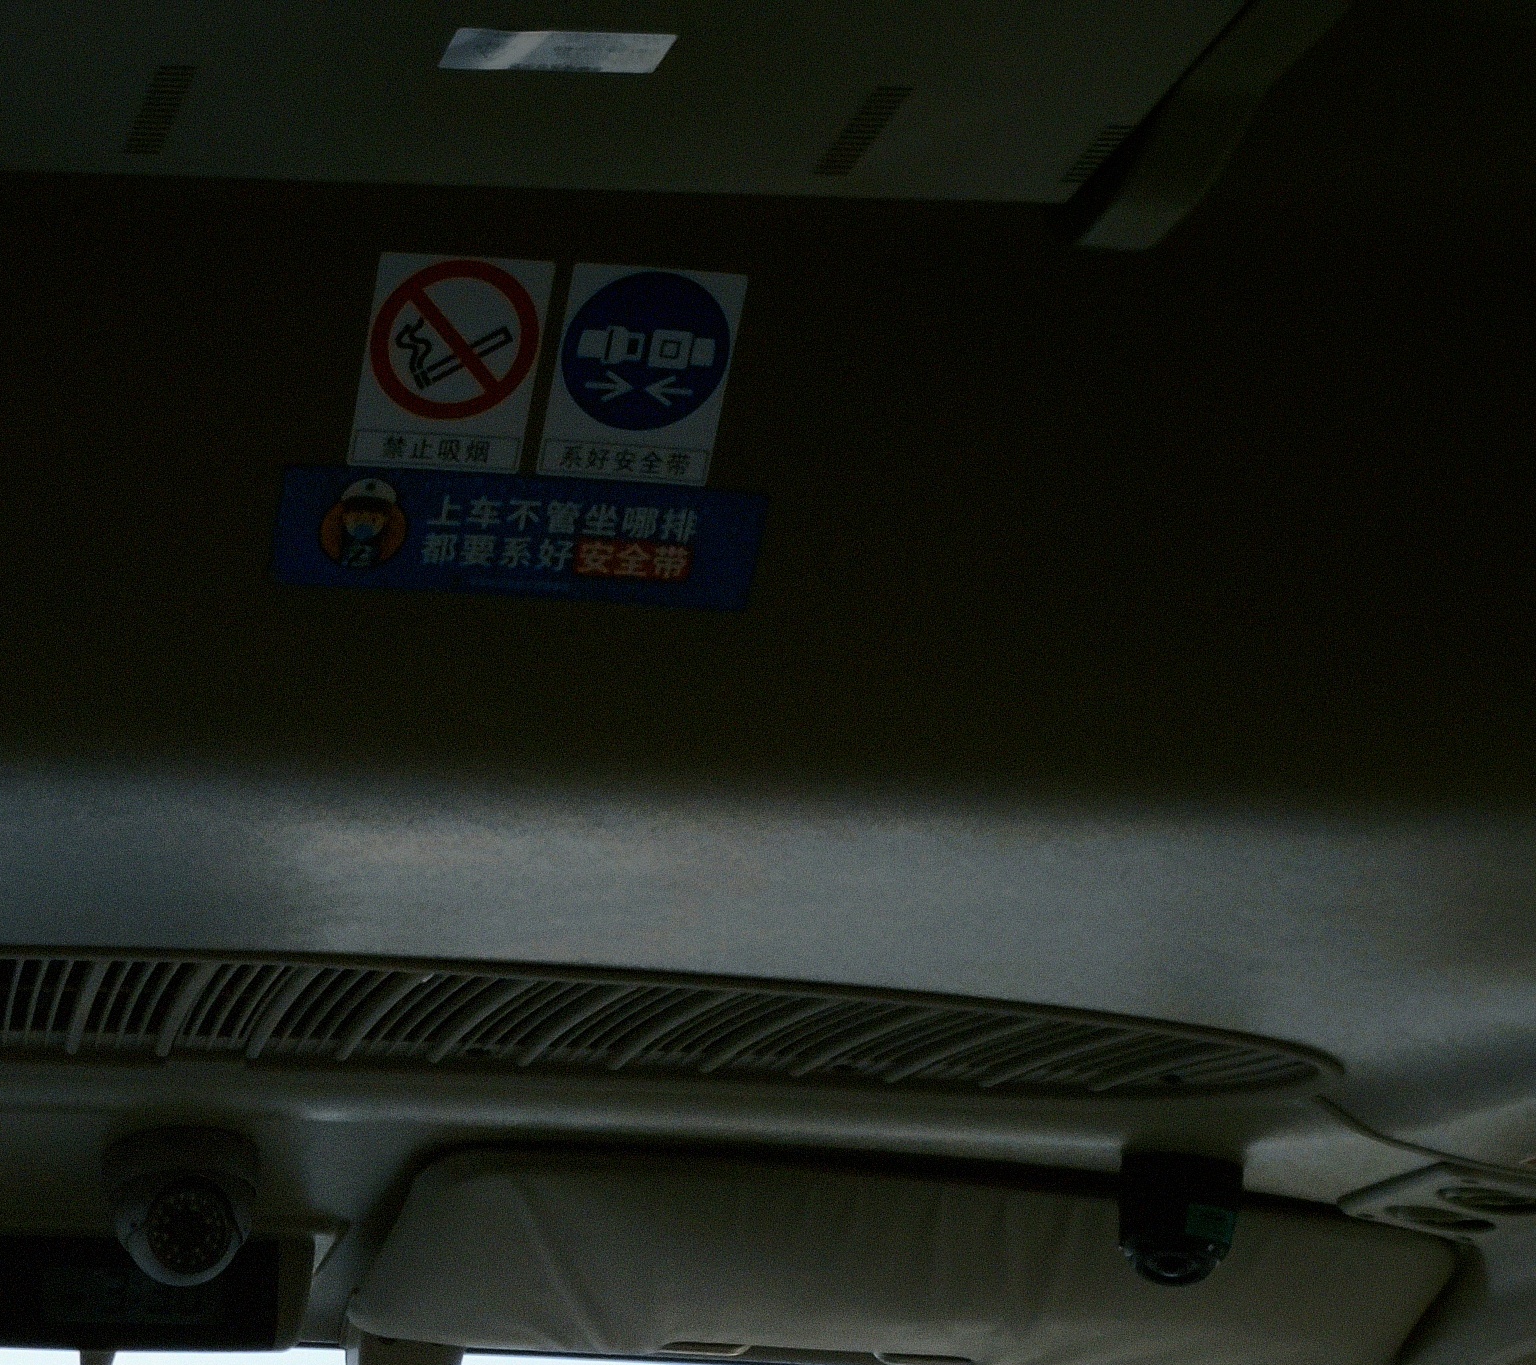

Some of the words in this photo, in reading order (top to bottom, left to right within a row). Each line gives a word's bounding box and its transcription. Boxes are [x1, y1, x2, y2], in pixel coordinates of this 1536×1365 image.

[381, 436, 491, 465] 禁止吸烟
[560, 445, 692, 477] 系好安全带
[426, 494, 700, 544] 上车不管坐哪排
[419, 532, 690, 579] 都要系好安全带
